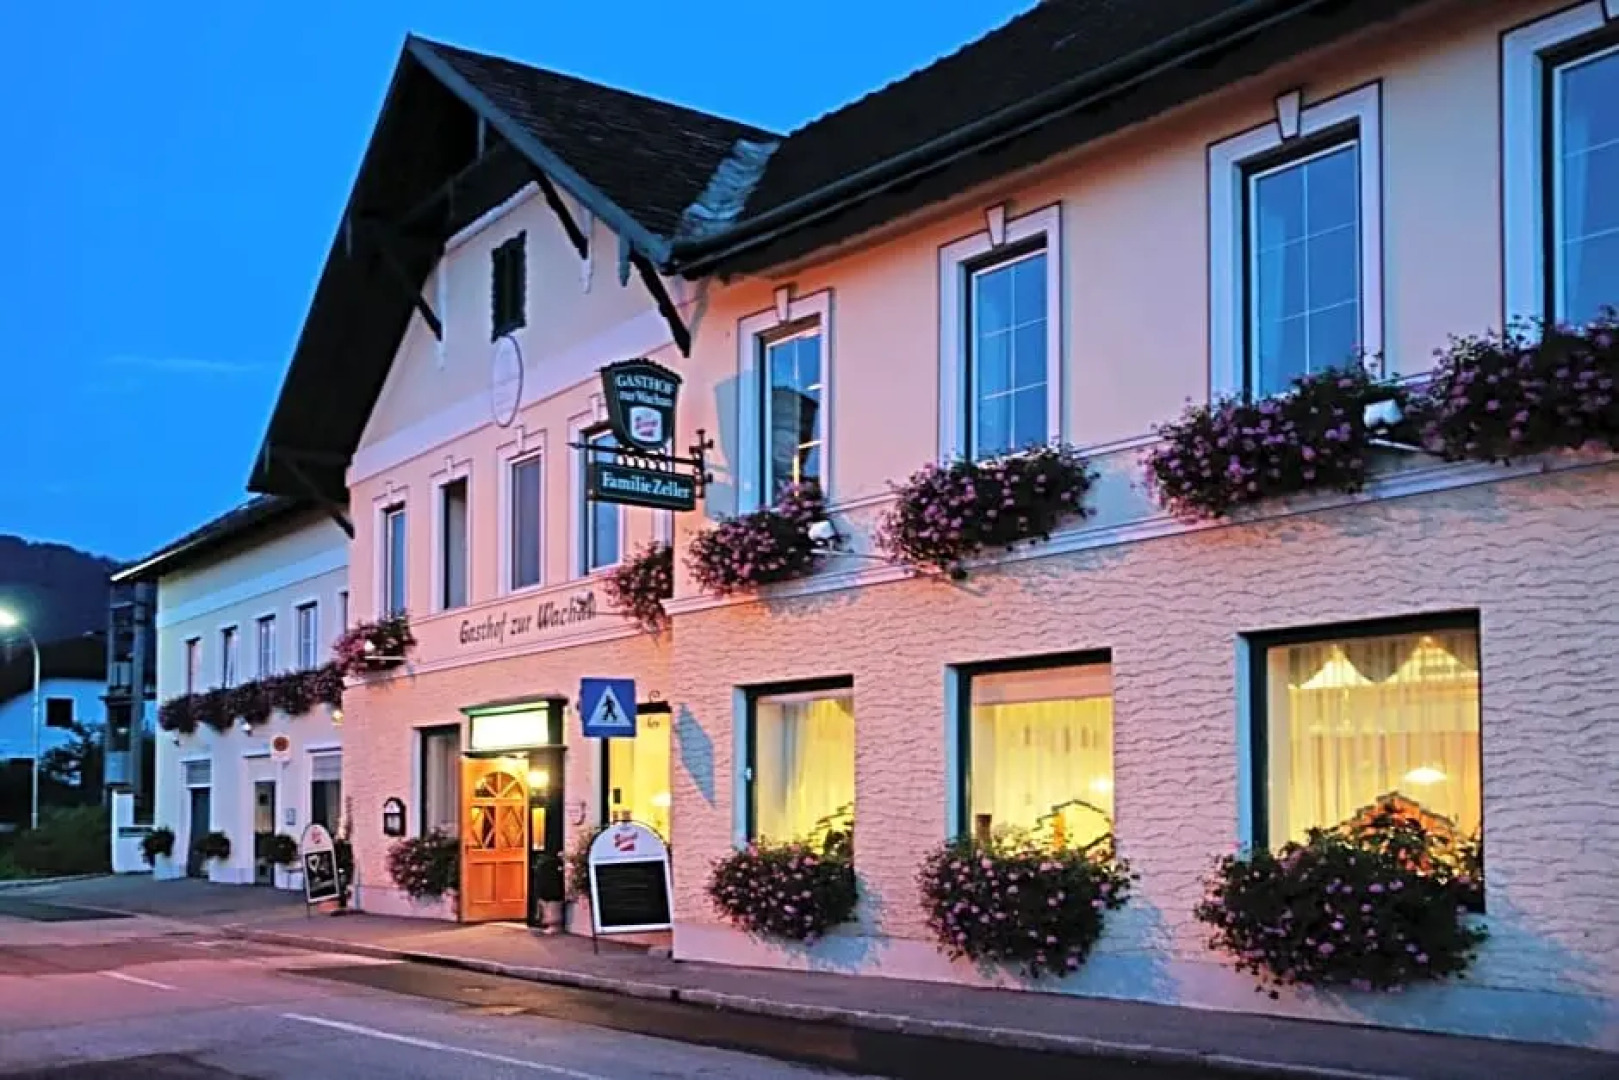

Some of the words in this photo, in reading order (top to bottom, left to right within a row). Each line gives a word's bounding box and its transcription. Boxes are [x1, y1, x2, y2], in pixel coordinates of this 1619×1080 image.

[614, 374, 676, 393] GASTHOF
[602, 472, 651, 492] Familie
[652, 480, 690, 499] Zeller
[460, 612, 507, 644] Gasthof
[510, 615, 532, 634] zur
